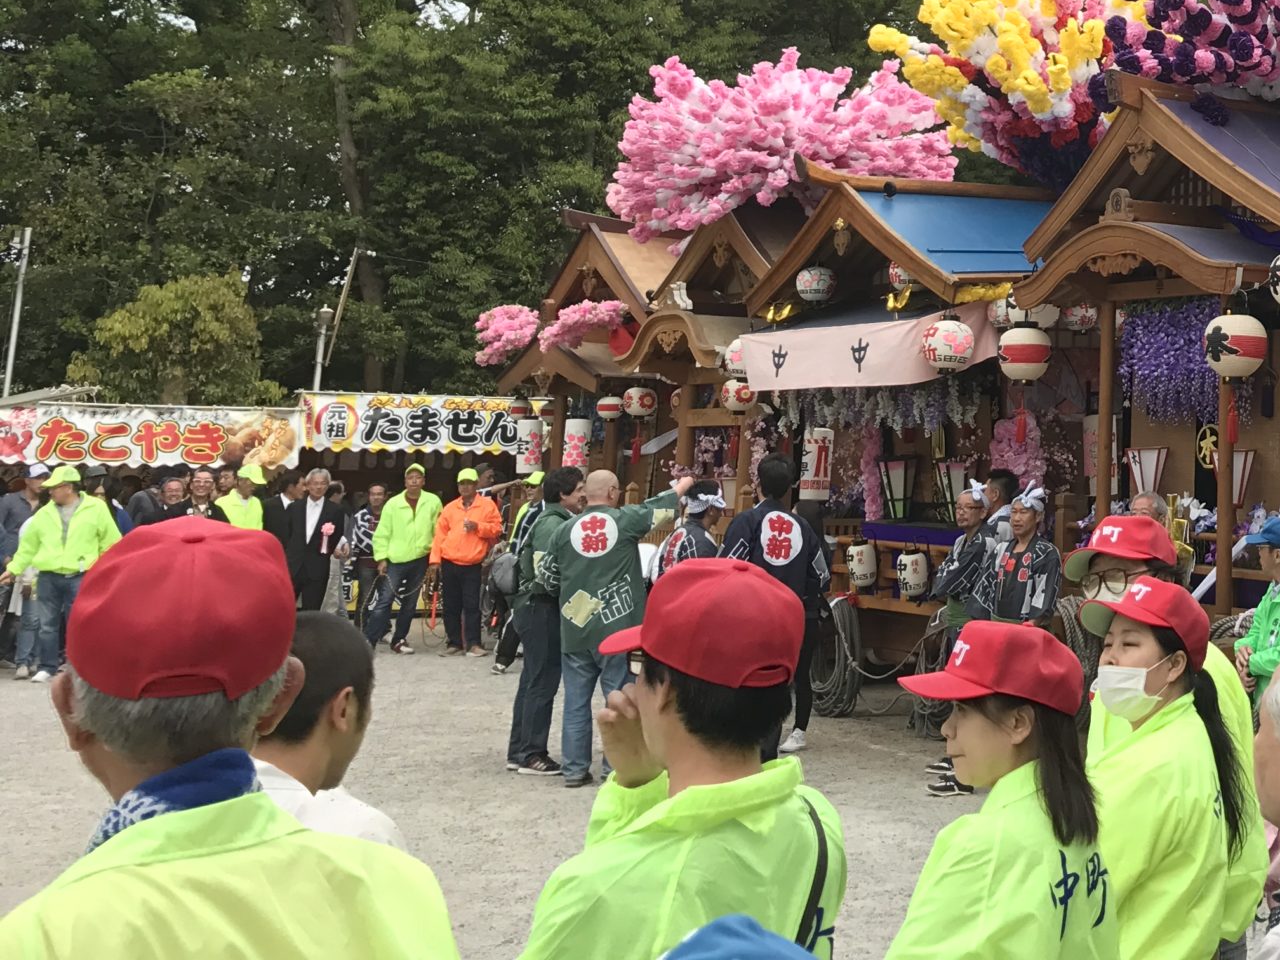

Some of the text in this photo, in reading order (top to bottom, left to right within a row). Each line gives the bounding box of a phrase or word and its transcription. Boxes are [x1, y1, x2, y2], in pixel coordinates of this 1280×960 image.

[1205, 325, 1242, 363] 本
[36, 416, 228, 464] たこやき
[326, 405, 347, 438] 元祖
[361, 406, 518, 444] たません
[580, 514, 608, 554] 中新
[765, 514, 794, 560] 中新
